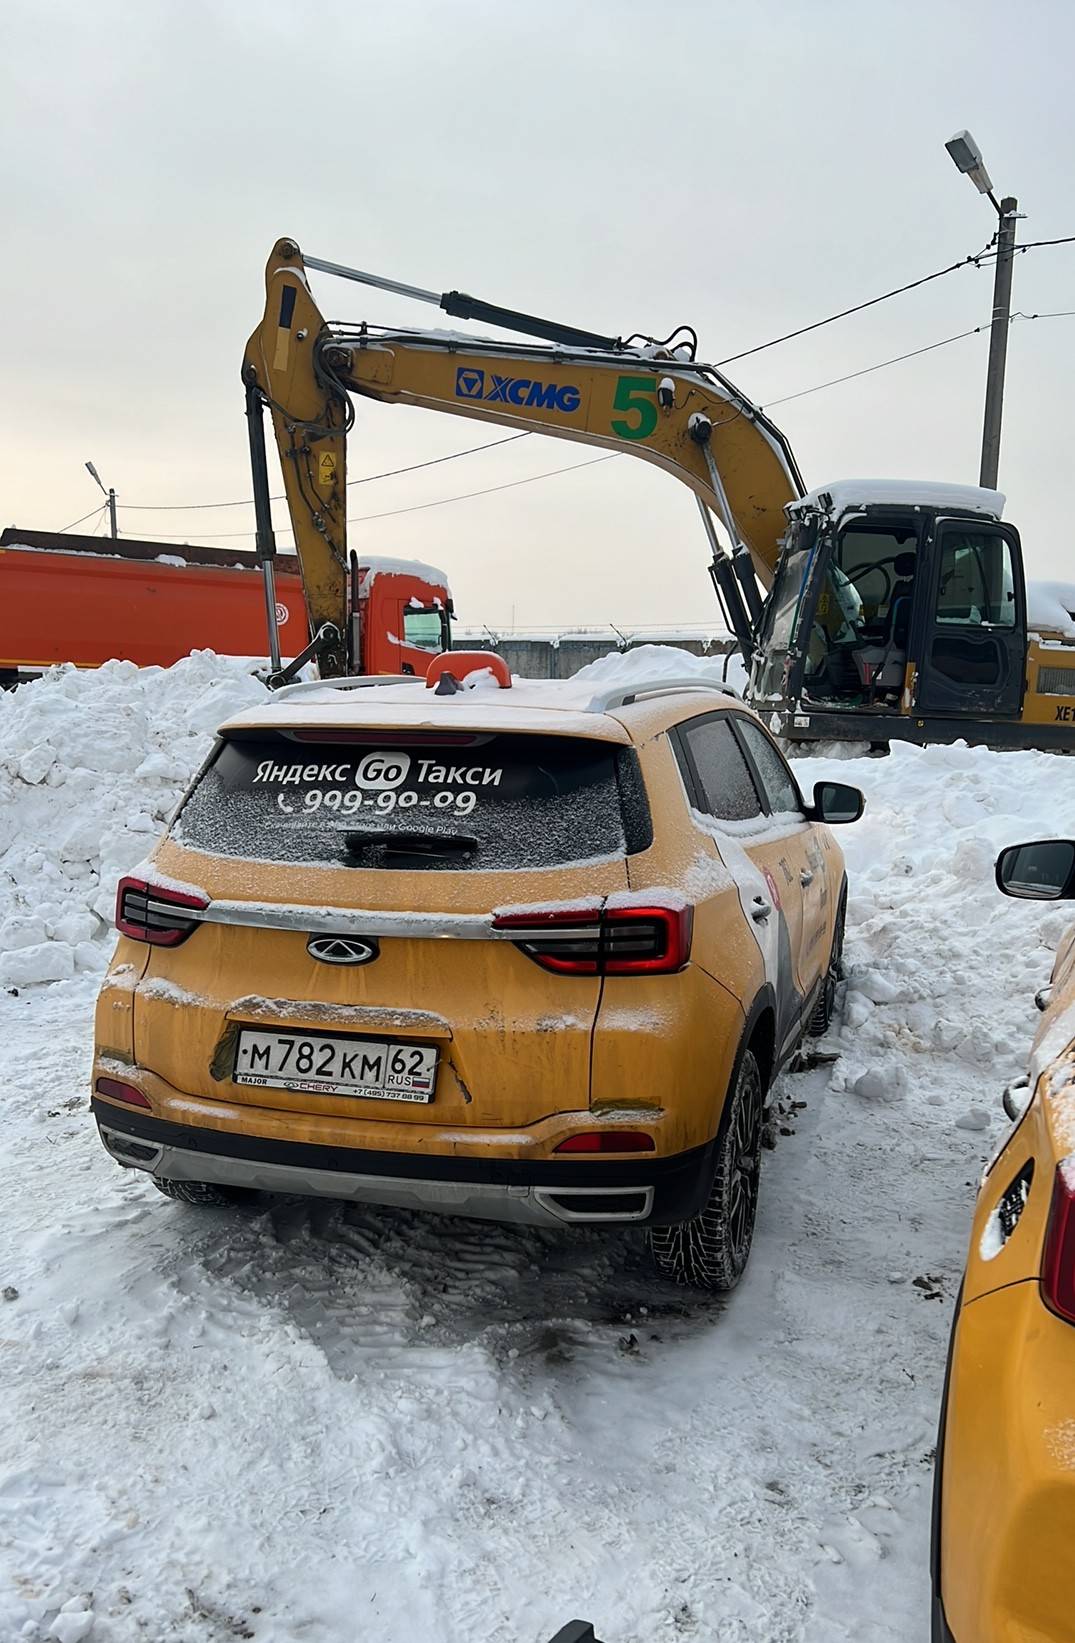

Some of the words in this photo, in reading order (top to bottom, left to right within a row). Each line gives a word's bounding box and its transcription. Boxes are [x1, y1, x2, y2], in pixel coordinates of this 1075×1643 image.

[484, 375, 581, 412] XCMG
[611, 375, 658, 439] 5
[252, 760, 351, 784] Яндекс
[362, 758, 402, 782] Go
[417, 760, 503, 786] Такси
[302, 789, 477, 816] 999-90-09
[391, 1048, 424, 1077] 62
[241, 1077, 268, 1085] MAJOR
[299, 1083, 338, 1092] CHERY
[363, 1089, 385, 1098] (495)
[387, 1074, 412, 1086] RUS
